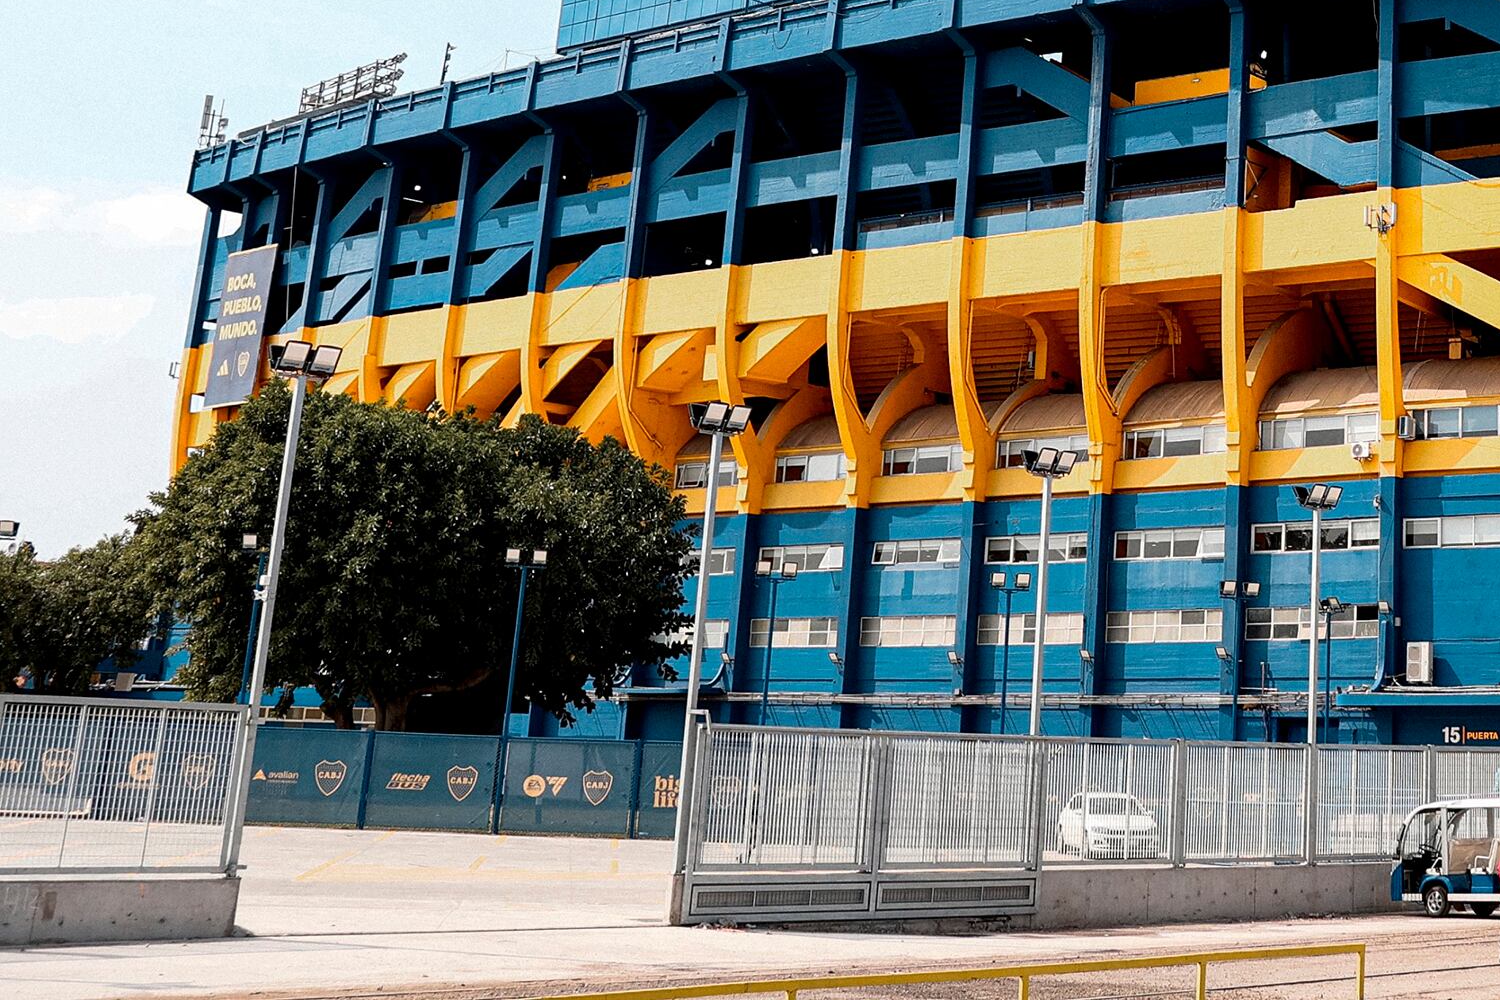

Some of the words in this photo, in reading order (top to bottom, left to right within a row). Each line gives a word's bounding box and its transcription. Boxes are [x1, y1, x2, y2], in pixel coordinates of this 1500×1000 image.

[227, 273, 256, 292] BOCA,
[223, 295, 262, 316] PUEBLO,
[219, 319, 257, 340] MUNDO.
[1442, 726, 1461, 743] 15
[1466, 731, 1499, 740] PUERTA
[318, 771, 342, 779] CABJ
[450, 776, 473, 785] CABJ
[586, 781, 609, 789] CABJ
